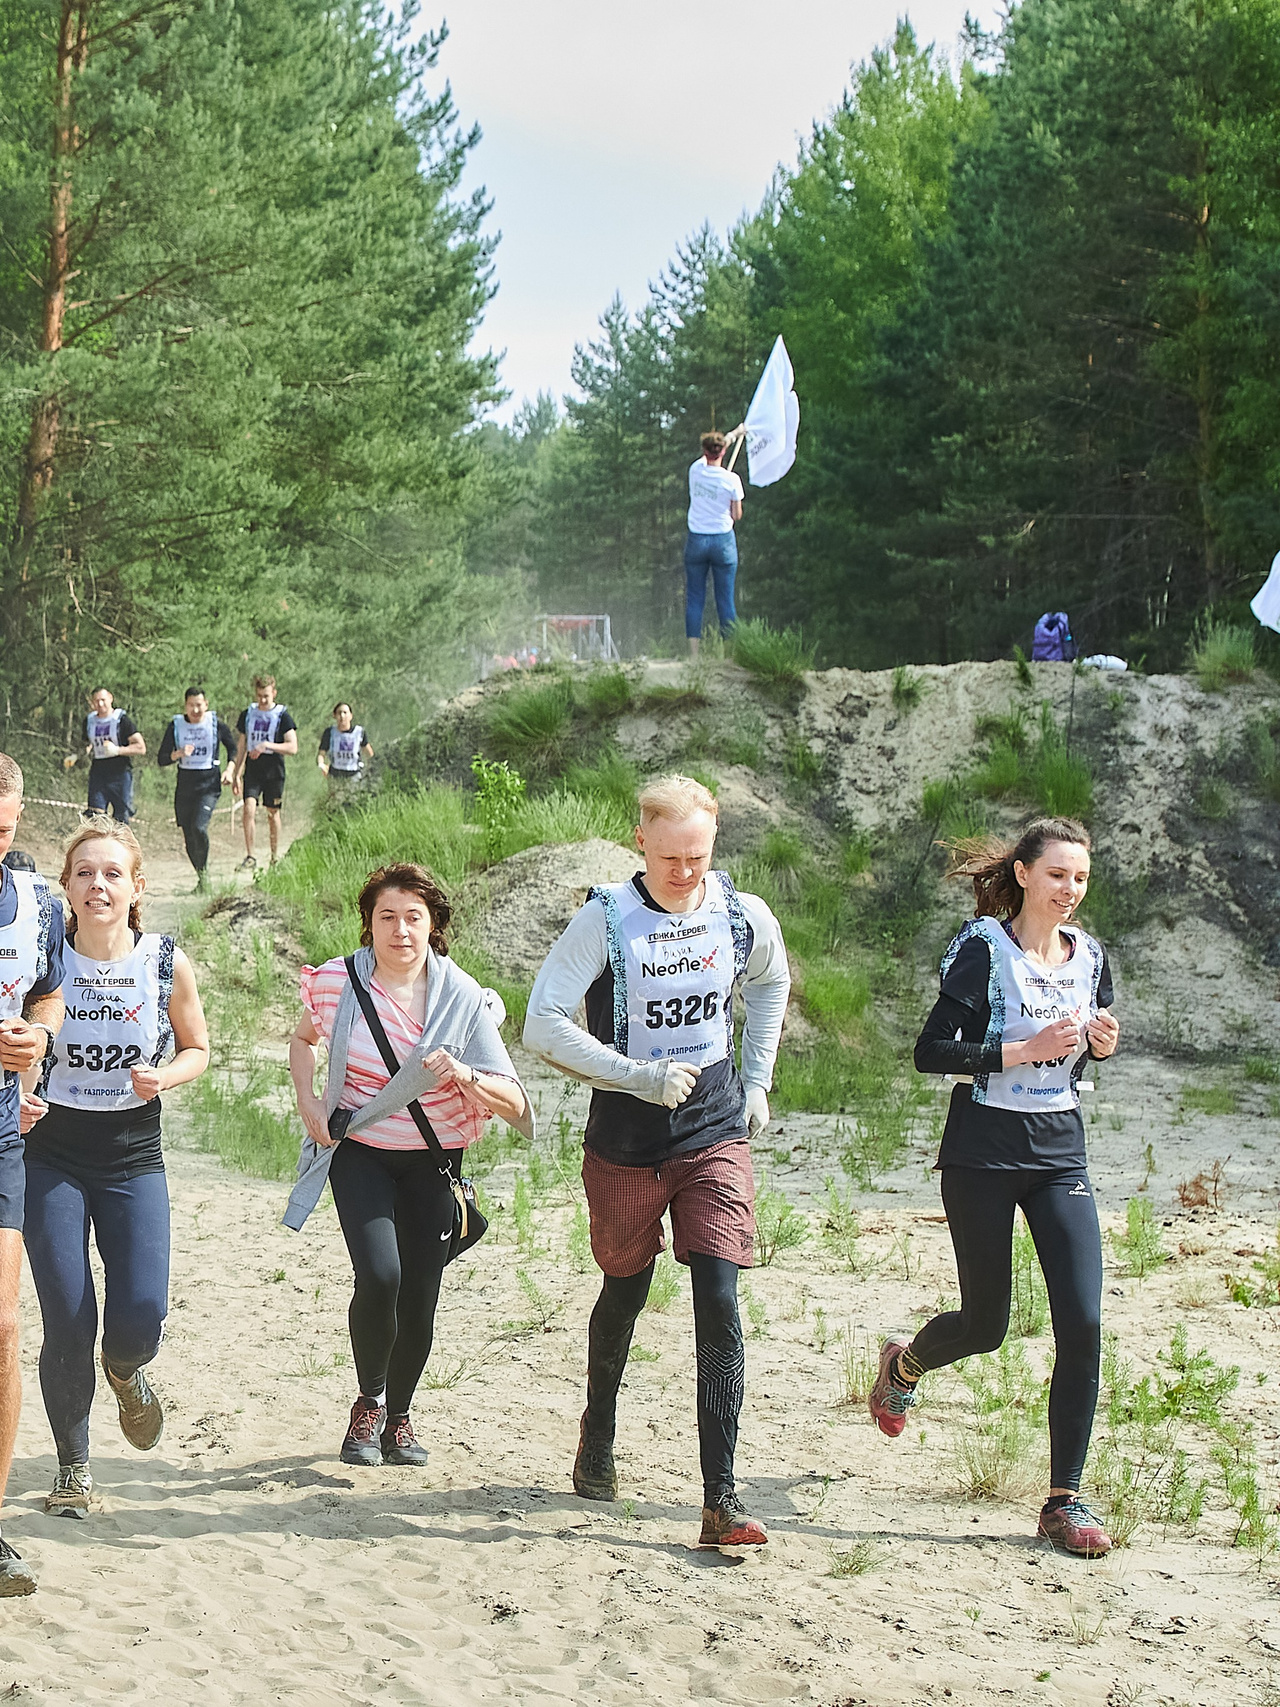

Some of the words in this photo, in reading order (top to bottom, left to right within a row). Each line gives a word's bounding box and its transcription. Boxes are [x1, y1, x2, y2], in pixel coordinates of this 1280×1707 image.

[648, 932, 676, 942] ГОНКА
[677, 924, 707, 938] ГЕРОЕВ
[642, 946, 720, 978] Neoflex
[74, 977, 101, 986] ГОНКА
[103, 977, 135, 986] ГЕРОЕВ
[64, 1002, 145, 1026] Neoflex
[646, 990, 719, 1030] 5326
[67, 1043, 142, 1073] 5322
[667, 1040, 715, 1056] ГАЗПРОМБАНК
